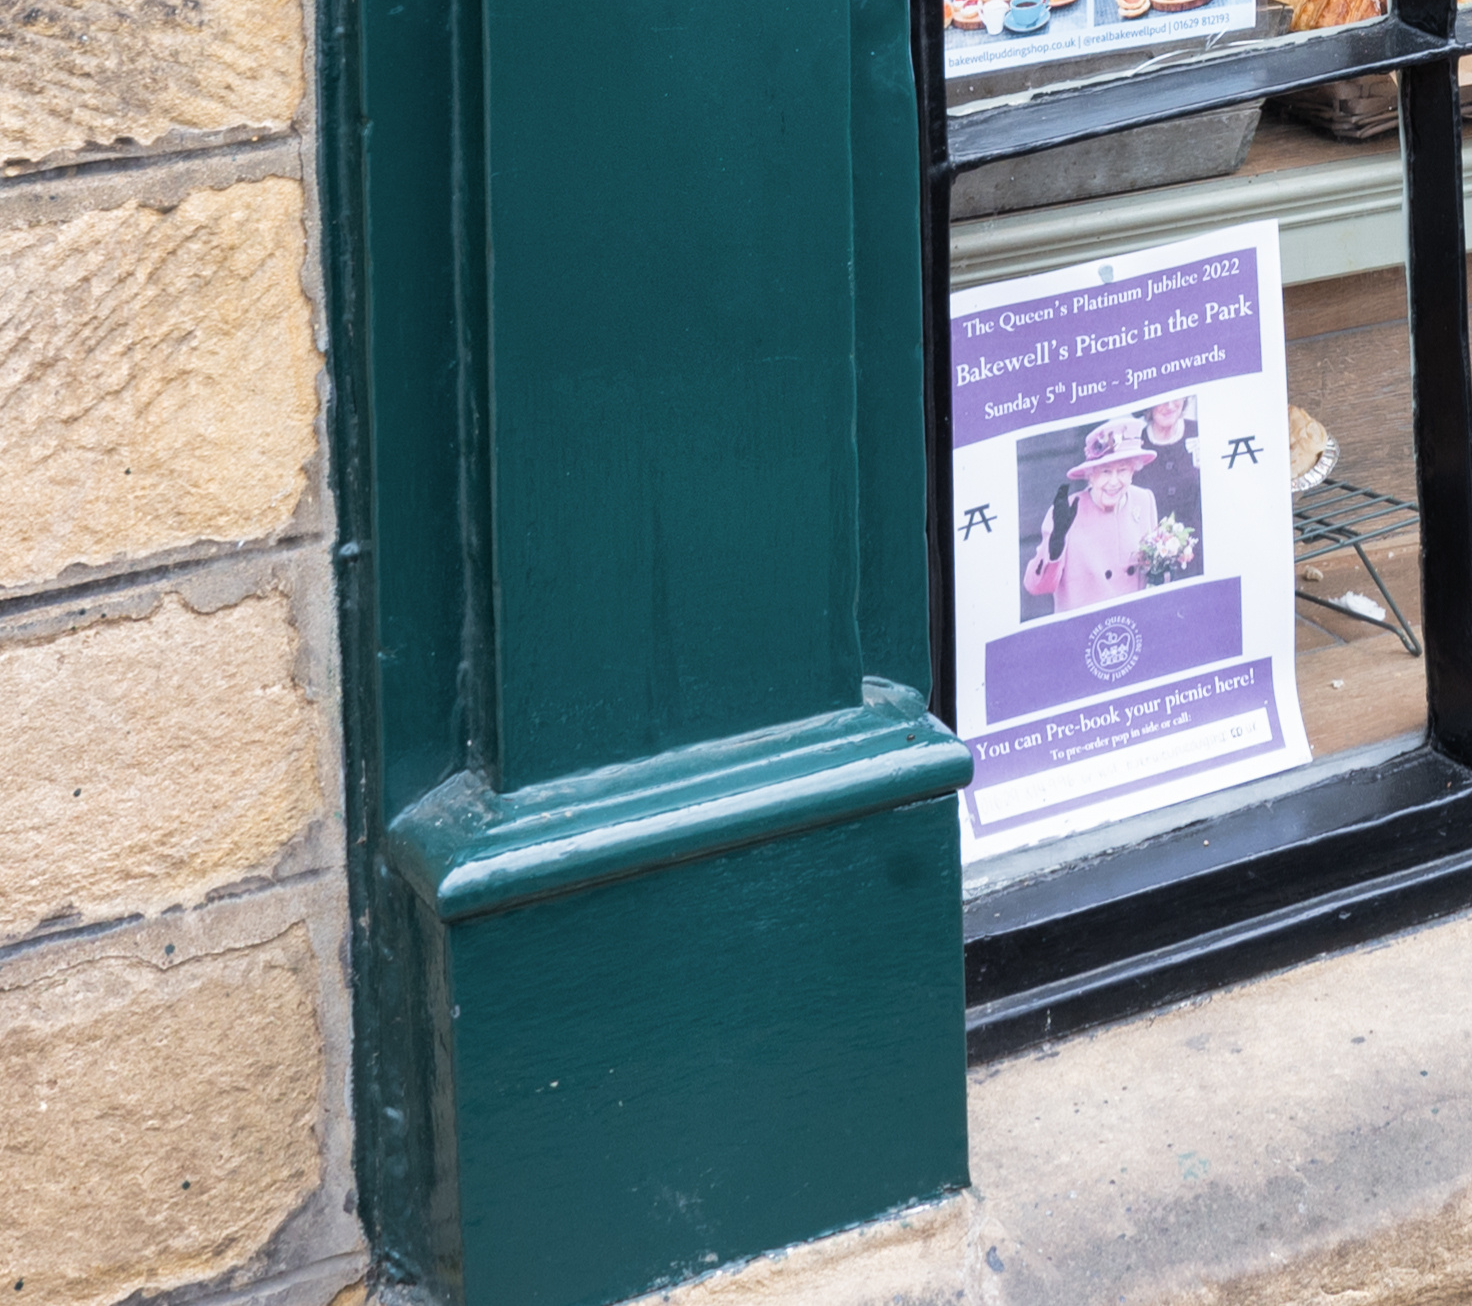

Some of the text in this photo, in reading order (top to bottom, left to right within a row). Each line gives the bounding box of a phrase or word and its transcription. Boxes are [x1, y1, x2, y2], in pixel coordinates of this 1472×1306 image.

[948, 38, 1076, 68] bakewellpuddingshop.co.uk
[1083, 24, 1166, 47] @realbakewellpud
[1173, 19, 1199, 31] 01629
[963, 258, 1240, 338] The Queen's Platinum Jubilee 2022
[956, 294, 1253, 386] Bakewell's Picnic in the Park
[985, 347, 1226, 419] Sunday 5th June 3pm onwards
[976, 667, 1254, 761] You can Pre-book your picnic here!
[1050, 712, 1192, 762] To pre-order pop in side or call:
